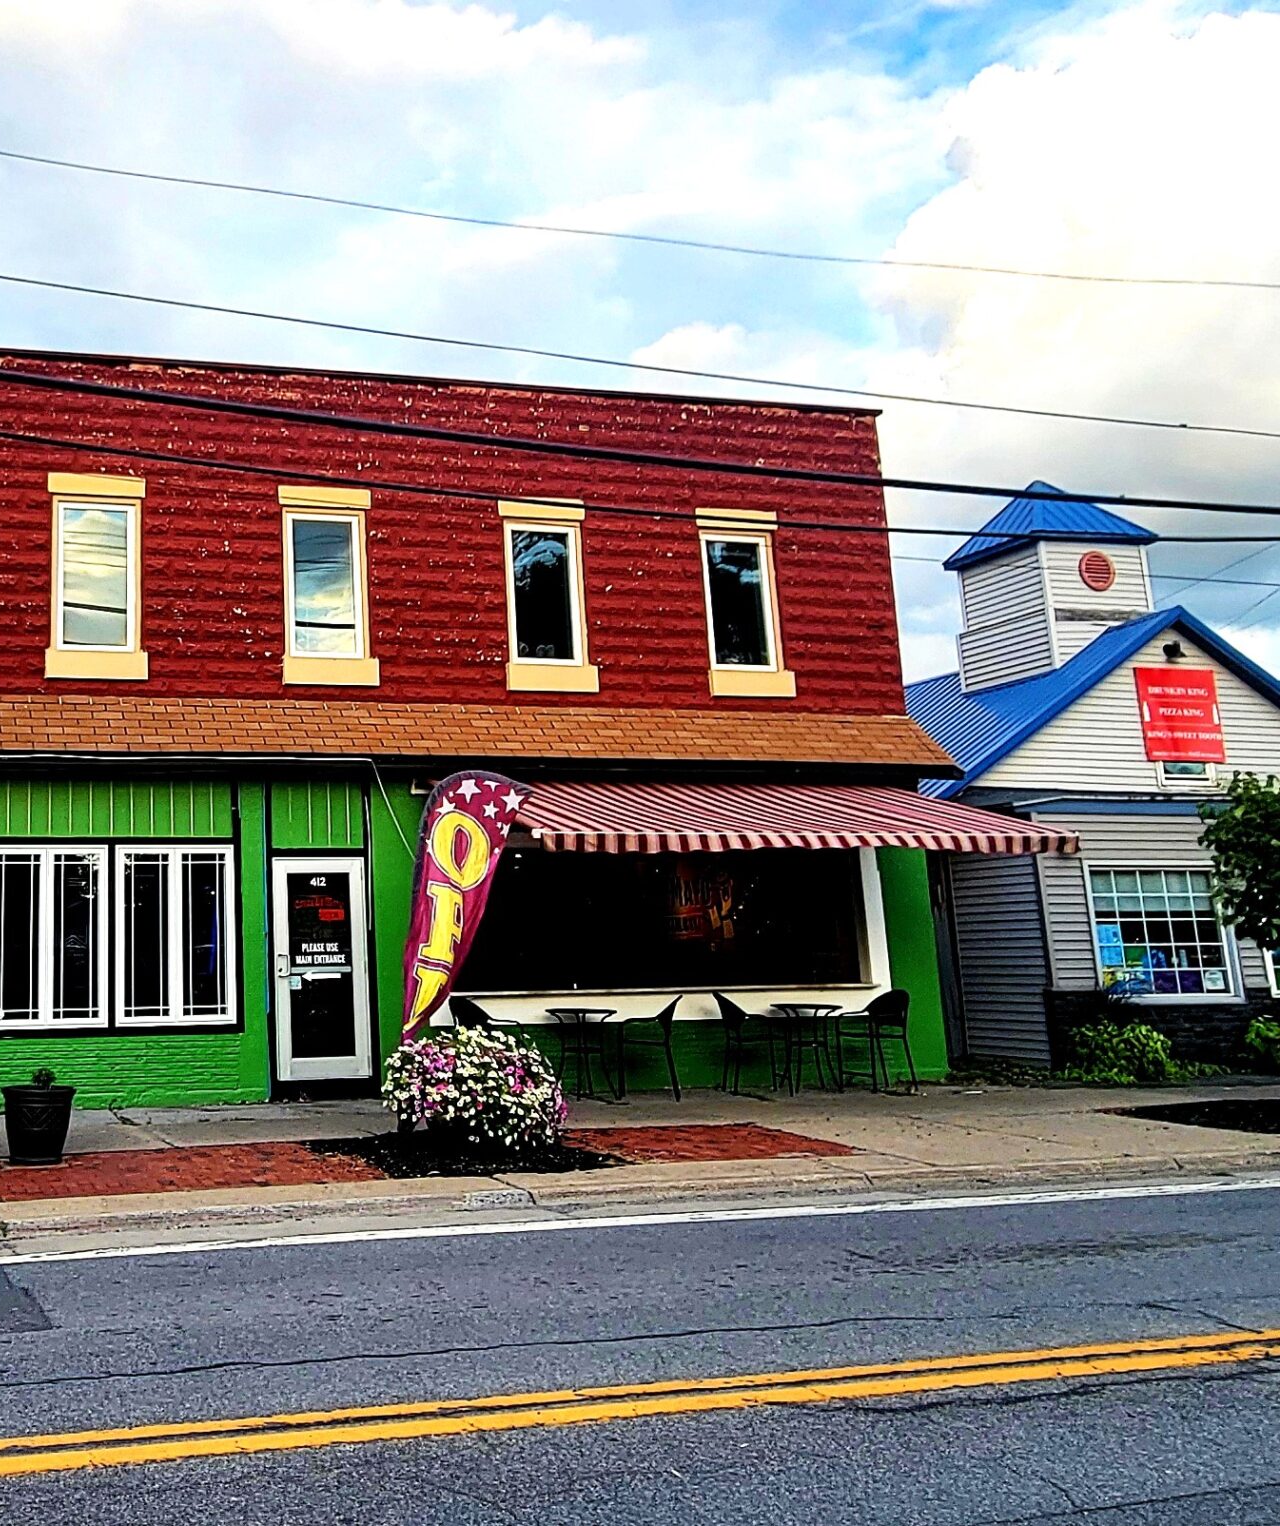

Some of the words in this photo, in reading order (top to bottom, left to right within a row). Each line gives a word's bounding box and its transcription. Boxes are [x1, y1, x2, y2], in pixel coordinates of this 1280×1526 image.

[1187, 687, 1208, 697] KING
[1158, 707, 1182, 716] PIZZA
[1183, 708, 1204, 717] KING
[310, 877, 326, 886] 412
[404, 809, 491, 1032] OP
[301, 943, 325, 952] PLEASE
[326, 942, 339, 952] USE
[295, 955, 312, 964] MAIN
[313, 954, 346, 964] ENTRANCE
